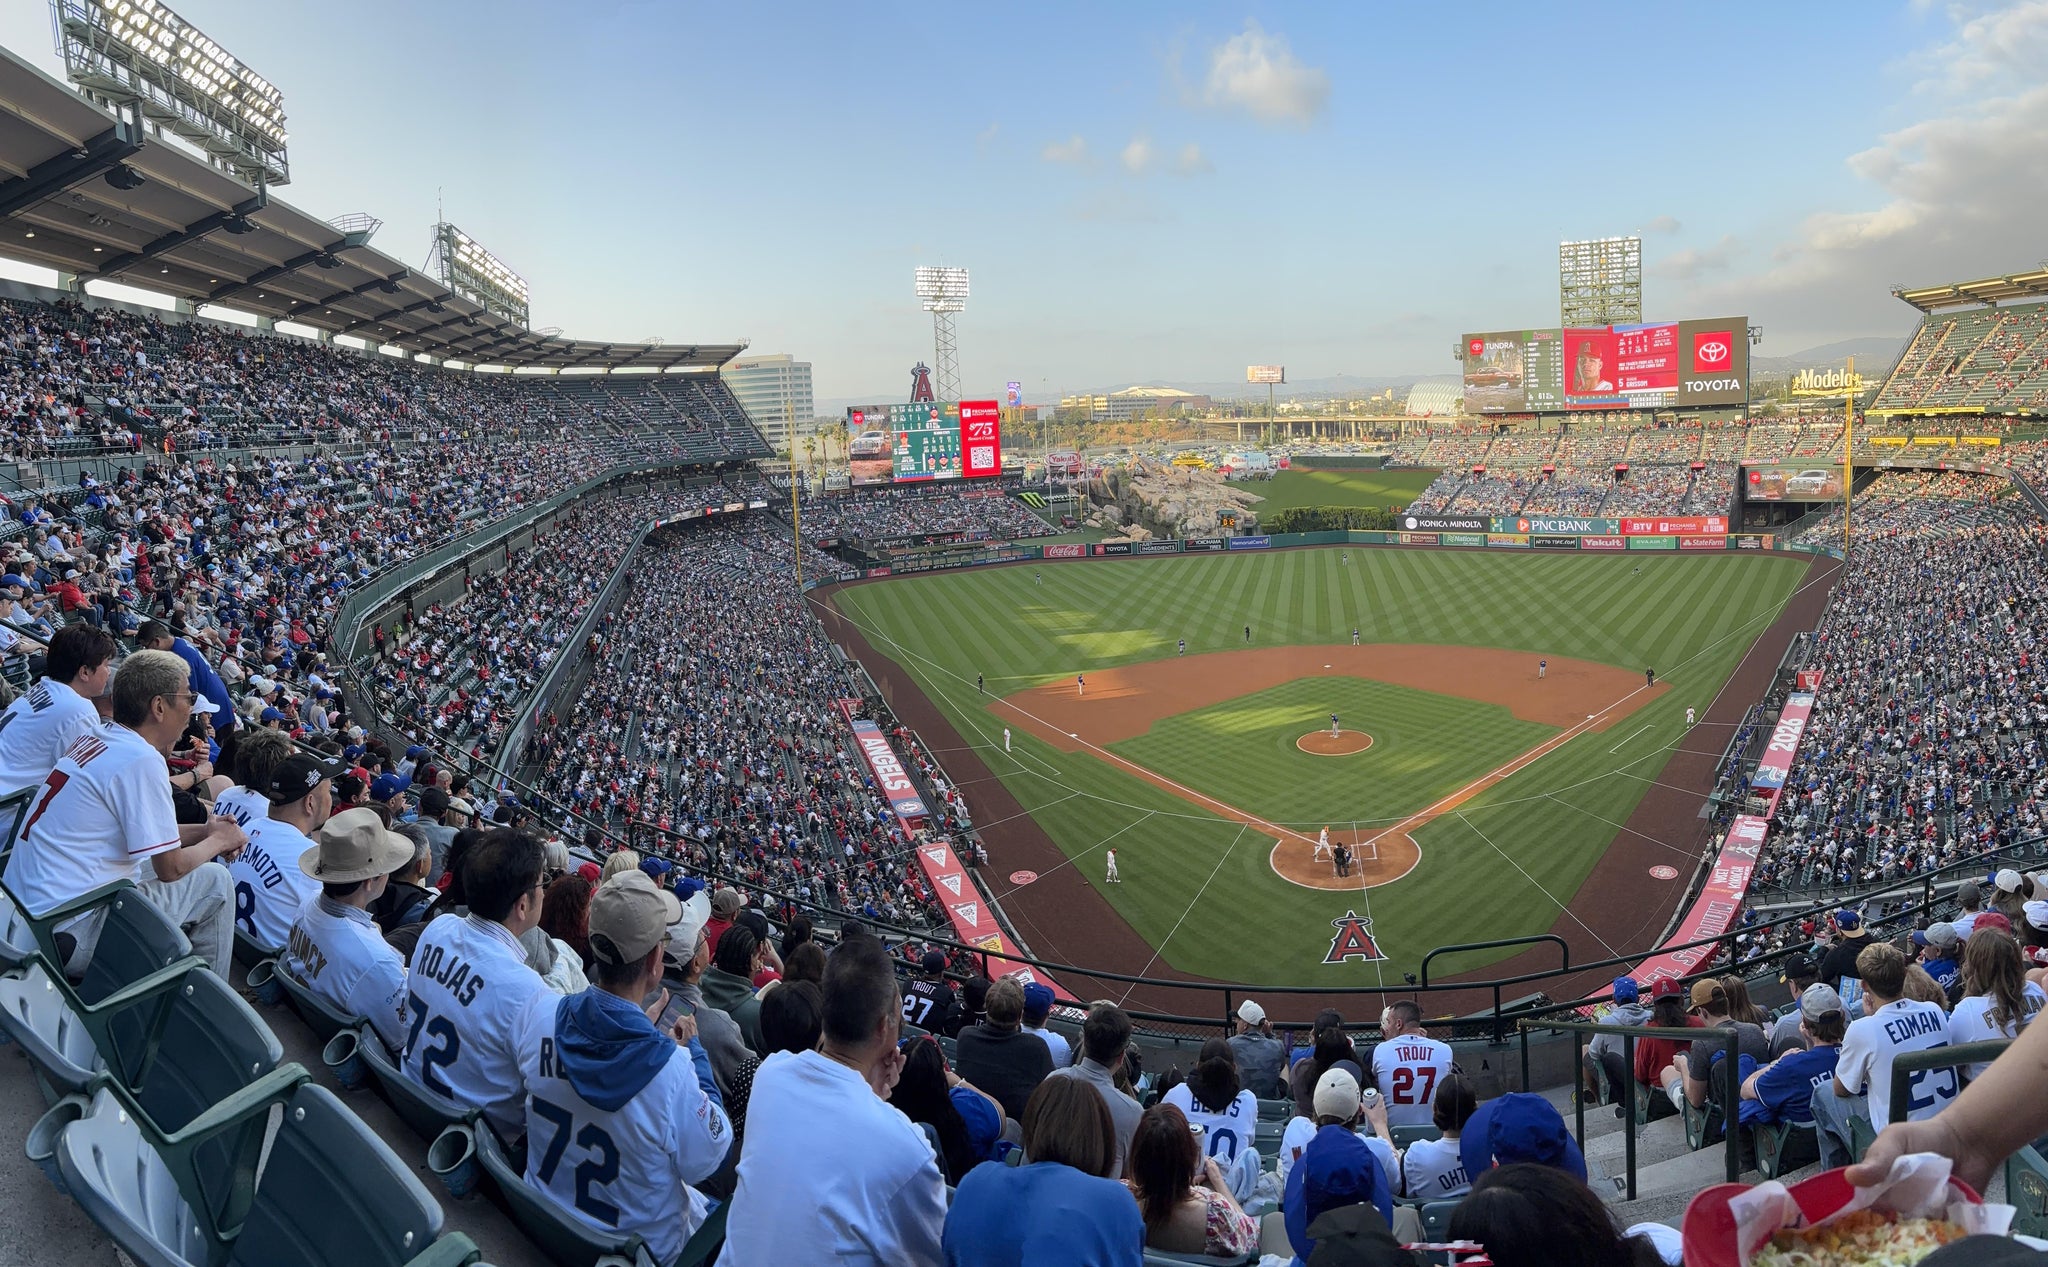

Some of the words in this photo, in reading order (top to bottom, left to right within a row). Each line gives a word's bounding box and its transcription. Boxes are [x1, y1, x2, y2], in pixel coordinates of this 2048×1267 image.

[1486, 341, 1514, 350] TUNDRA
[1685, 378, 1740, 392] TOYOTA
[1801, 368, 1851, 388] Modelo
[968, 422, 993, 437] $75
[1419, 520, 1448, 528] KONICA
[1449, 520, 1482, 528] MINOLTA
[1633, 523, 1652, 531] BTV
[1585, 538, 1622, 547] Yakult
[1769, 718, 1804, 752] 2026
[861, 738, 911, 791] ANGELS
[20, 768, 70, 842] 7
[231, 842, 282, 890] AMOTO
[235, 880, 258, 938] 8
[1321, 910, 1390, 964] A
[416, 943, 485, 1007] ROJAS
[912, 980, 937, 995] TROUT
[901, 994, 934, 1025] 27
[1884, 1011, 1942, 1045] EDMAN
[403, 989, 462, 1101] 72
[1395, 1045, 1435, 1062] TROUT
[1392, 1066, 1437, 1105] 27
[1191, 1093, 1242, 1118] BES
[531, 1094, 621, 1228] 72
[1438, 1167, 1467, 1191] OHT
